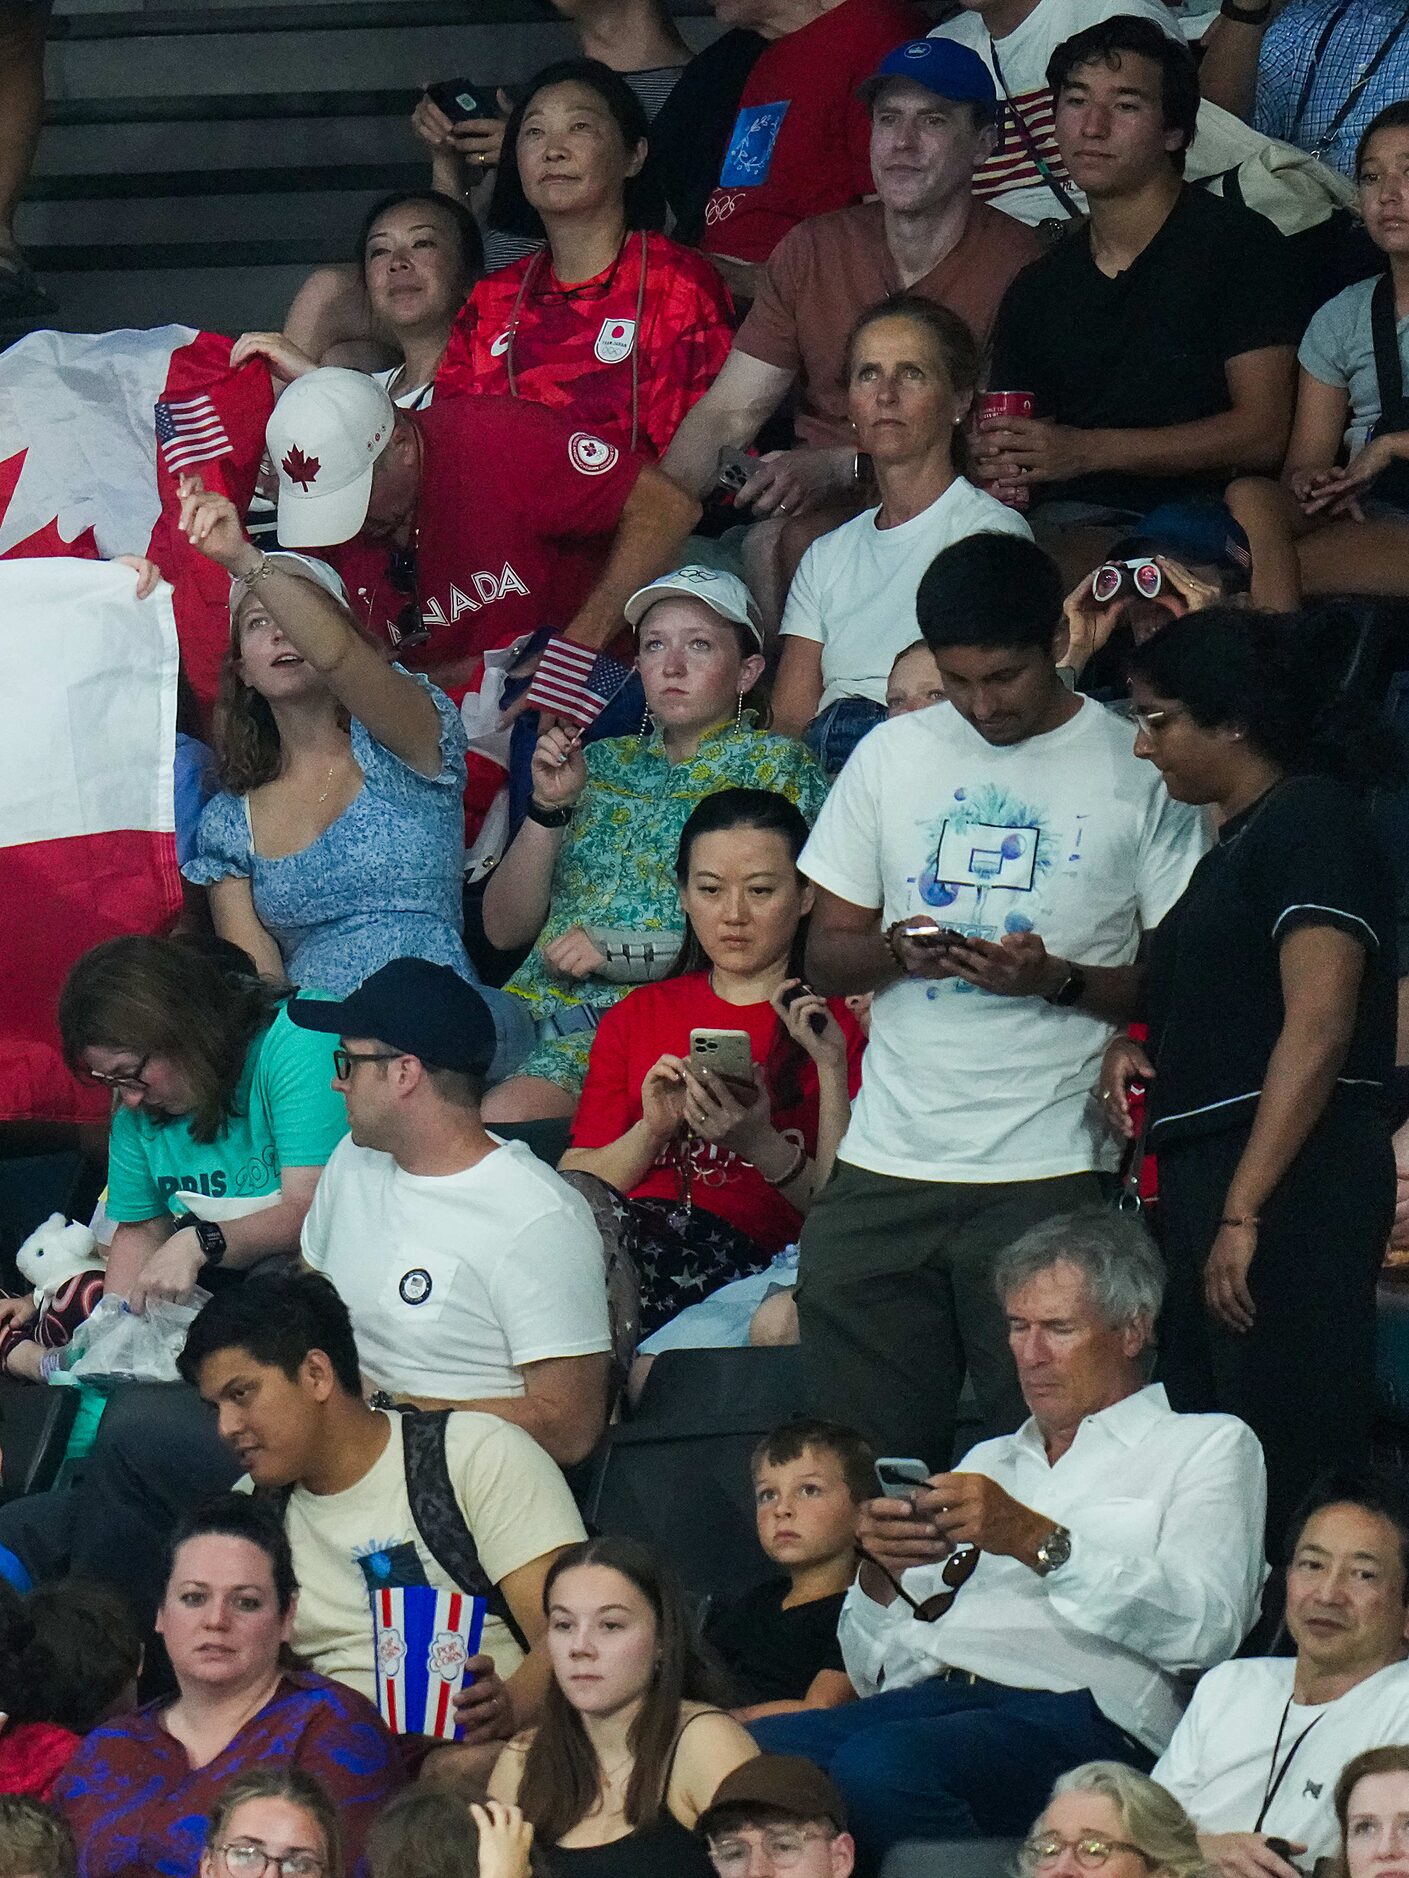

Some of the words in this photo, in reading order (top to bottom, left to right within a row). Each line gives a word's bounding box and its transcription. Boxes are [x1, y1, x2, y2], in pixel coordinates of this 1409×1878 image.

[387, 561, 531, 645] NADA
[436, 1641, 457, 1657] POP
[434, 1651, 463, 1669] CORN
